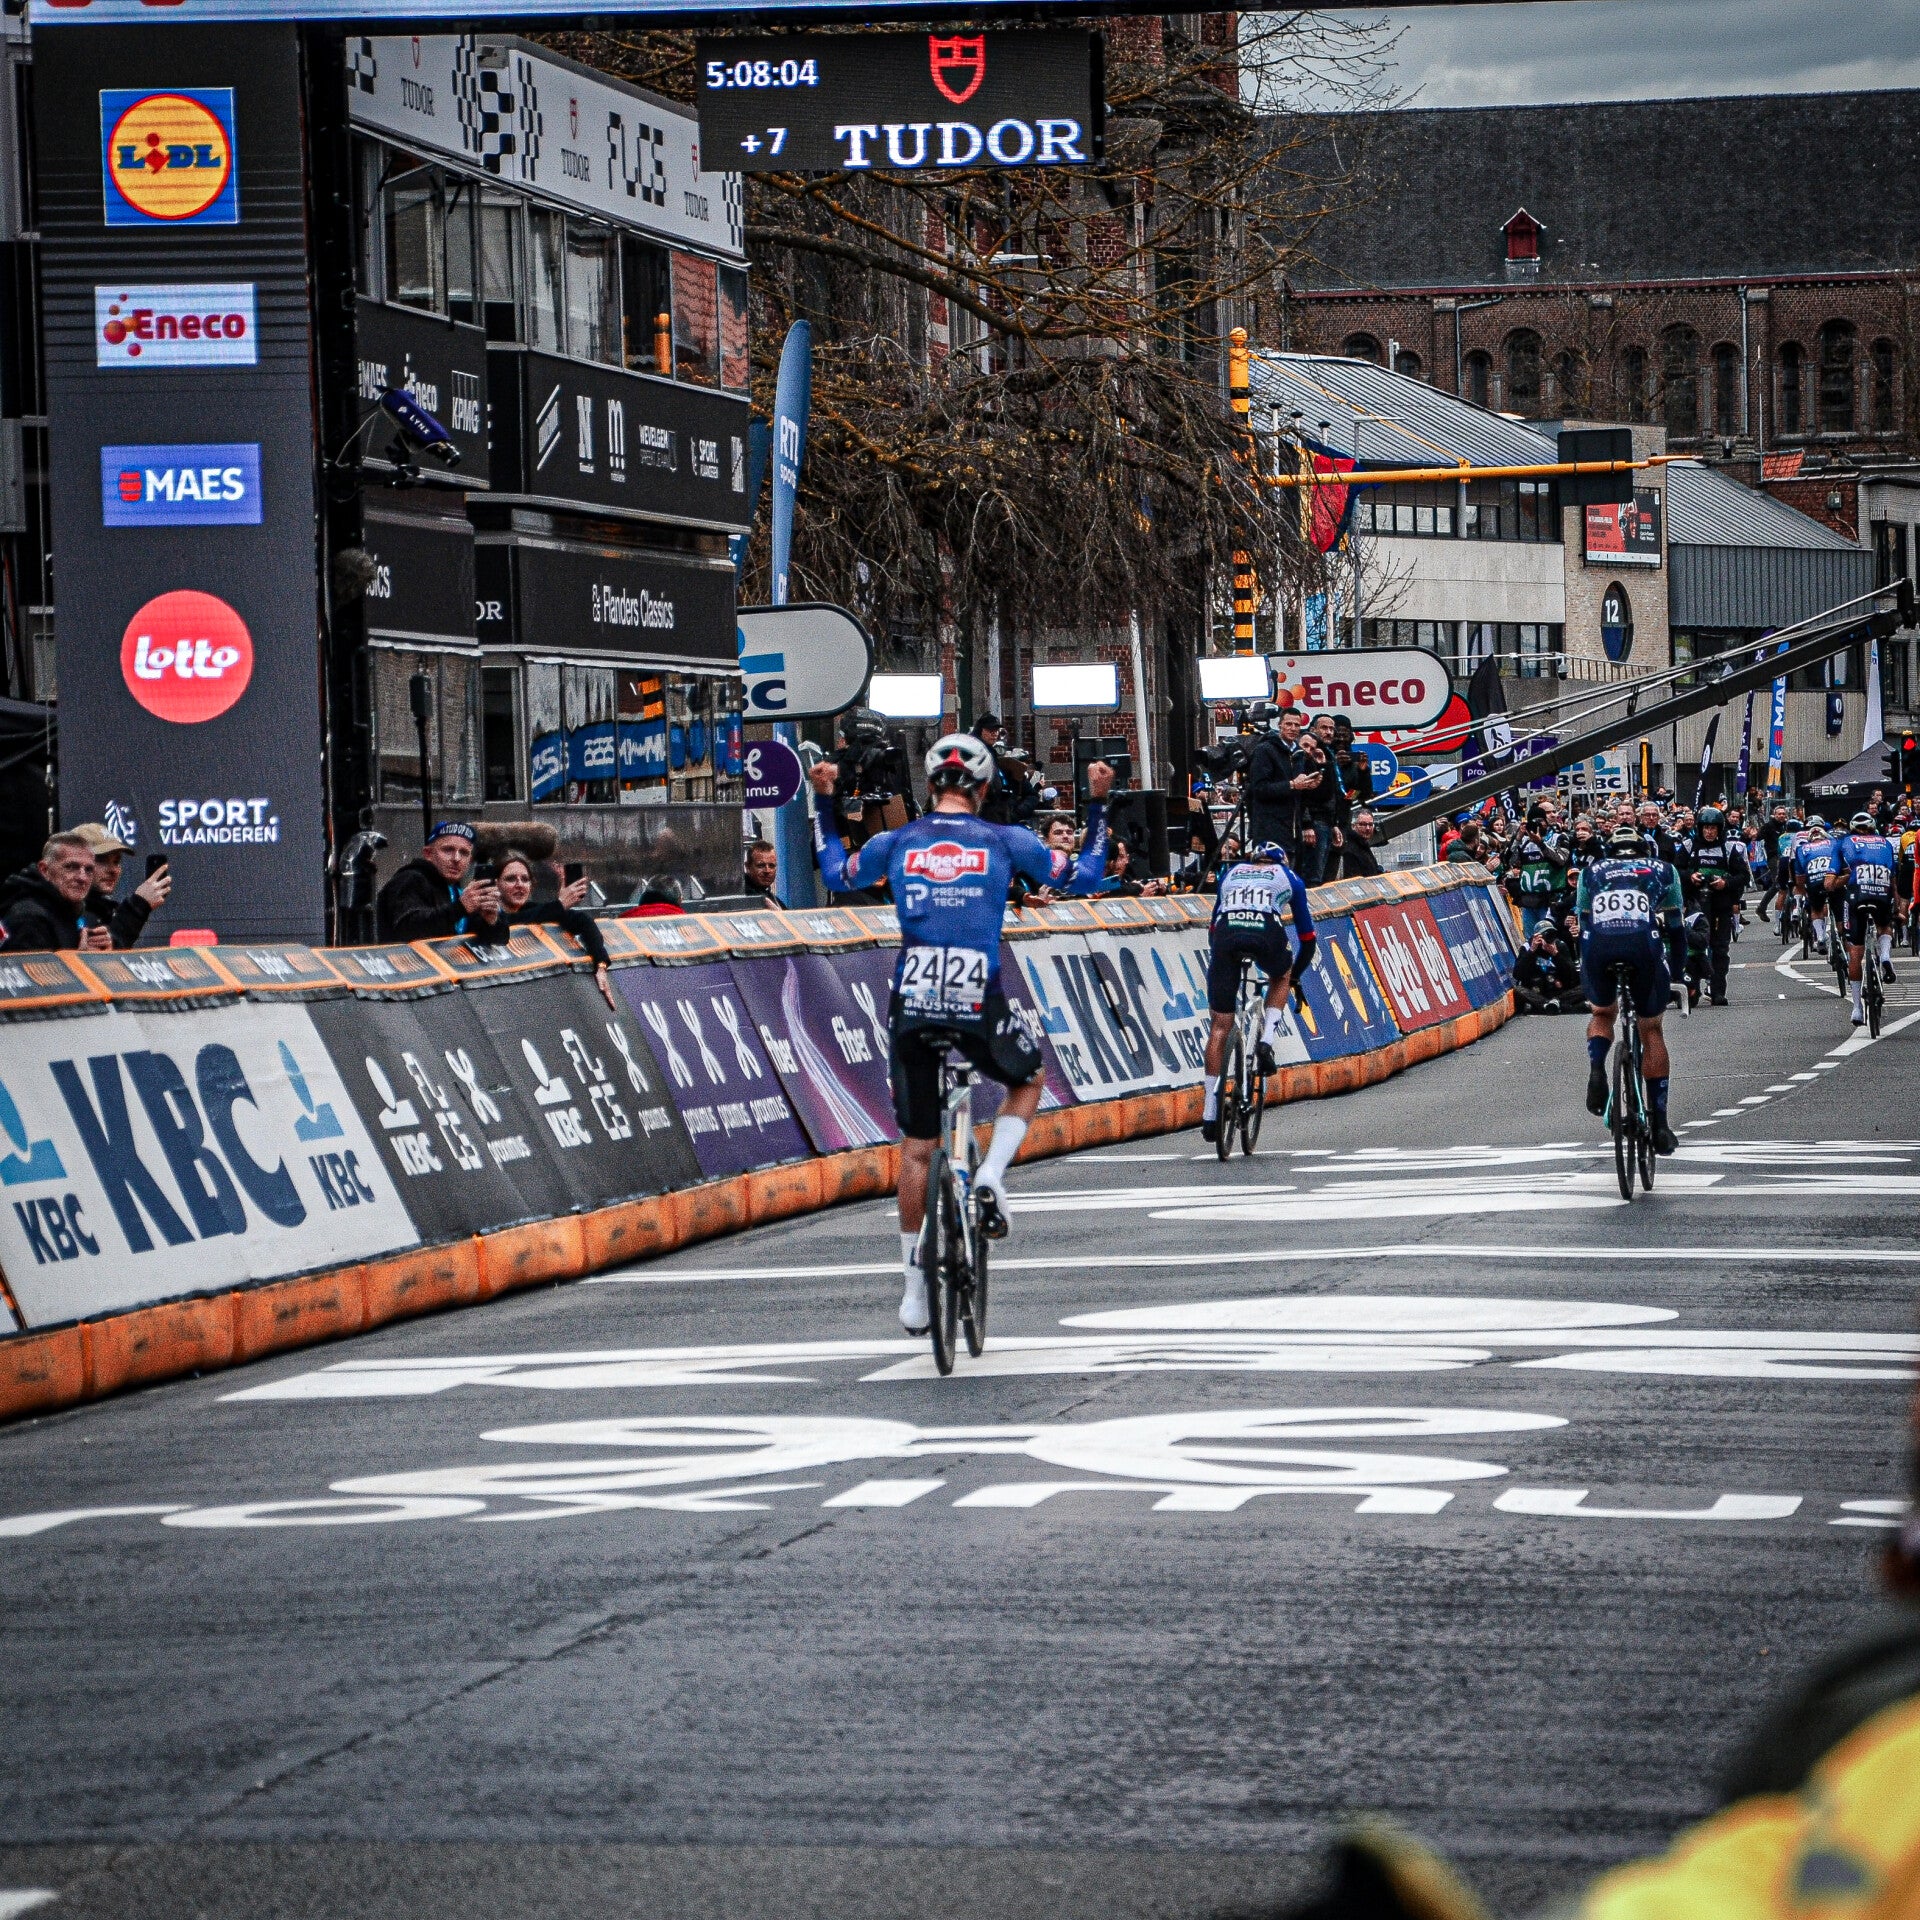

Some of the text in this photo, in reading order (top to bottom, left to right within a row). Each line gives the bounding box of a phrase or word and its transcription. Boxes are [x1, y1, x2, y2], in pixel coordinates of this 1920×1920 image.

[706, 59, 820, 88] 5:08:04
[400, 77, 435, 118] TUDOR
[740, 127, 789, 156] +7
[834, 118, 1087, 168] TUDOR
[561, 147, 591, 184] TUDOR
[684, 191, 710, 223] TUDOR
[131, 309, 246, 340] Eneco
[145, 467, 246, 502] MAES
[603, 585, 639, 627] Flanders
[640, 588, 674, 629] Classics
[1605, 599, 1619, 623] 12
[134, 635, 240, 680] lotto
[1301, 675, 1426, 708] Eneco
[1821, 784, 1849, 796] EMG
[159, 799, 279, 827] SPORT.
[159, 827, 279, 844] VLAANDEREN
[911, 851, 980, 871] Alpecin
[933, 898, 966, 907] TECH
[1227, 911, 1265, 922] BORA
[904, 954, 985, 989] 24 24
[1051, 947, 1181, 1083] KBC
[544, 1107, 593, 1148] KBC
[49, 1043, 307, 1255] KBC
[390, 1133, 443, 1177] KBC
[309, 1149, 375, 1210] KBC
[13, 1193, 100, 1265] KBC
